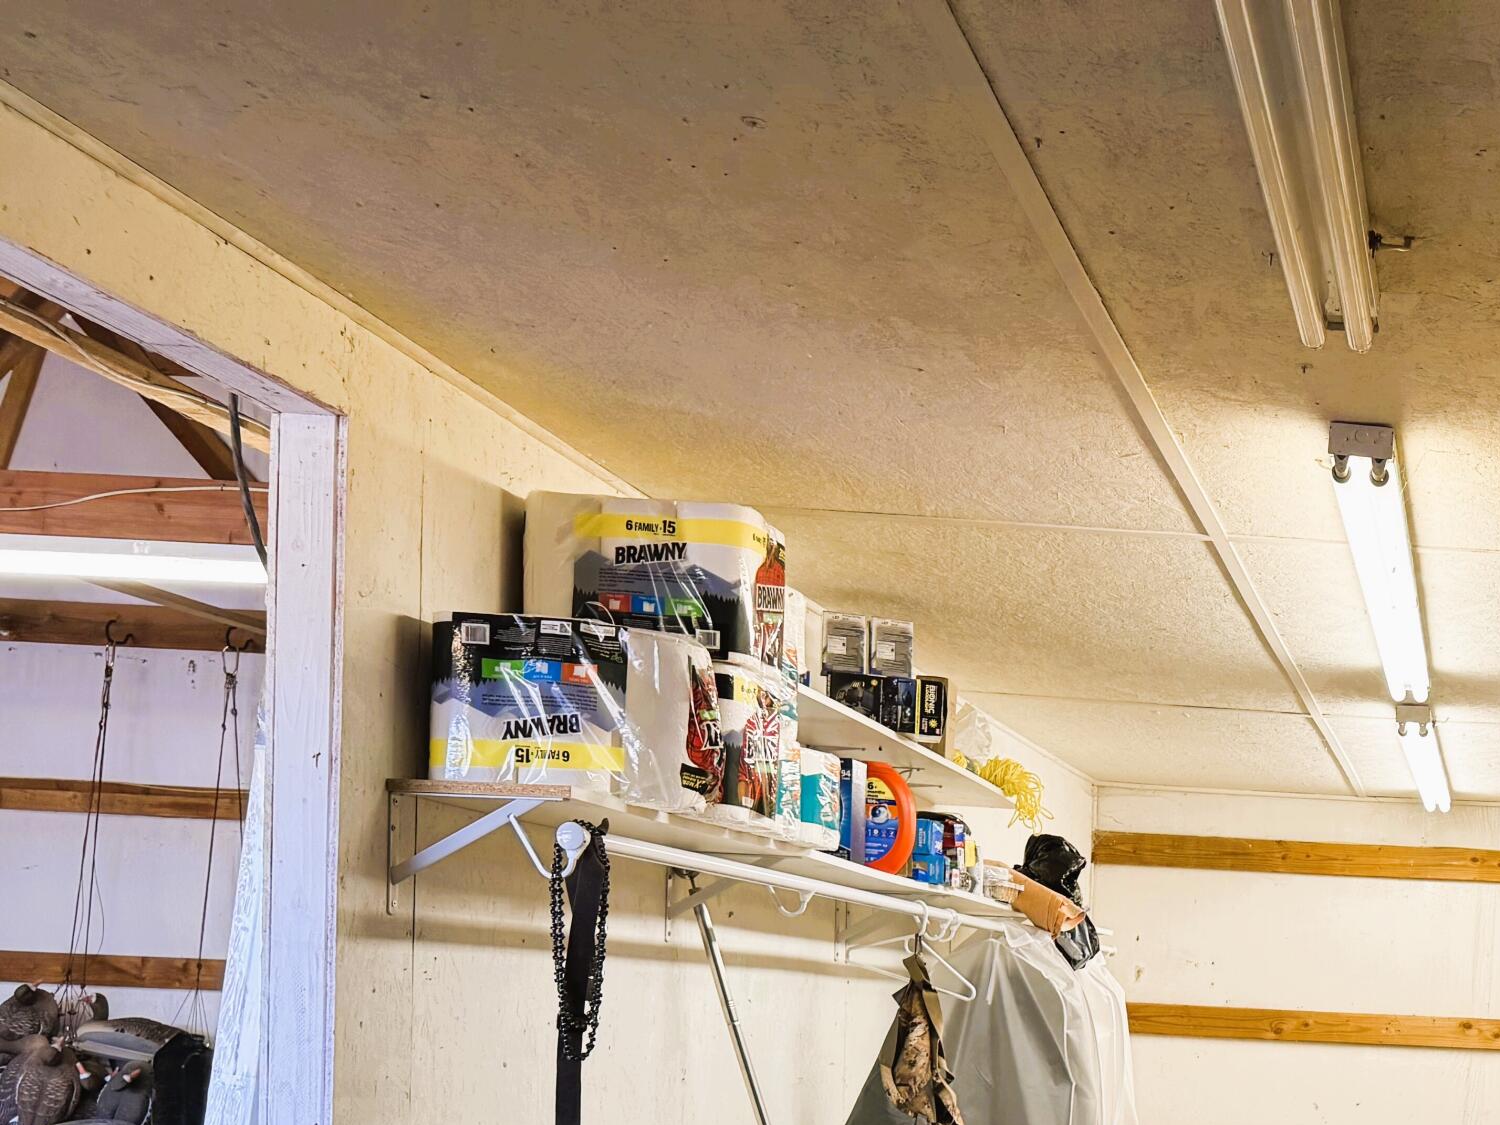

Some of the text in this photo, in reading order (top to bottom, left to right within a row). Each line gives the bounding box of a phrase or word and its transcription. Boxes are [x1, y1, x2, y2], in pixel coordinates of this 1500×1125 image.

[625, 519, 676, 532] 6 FAMILY 15
[614, 542, 687, 565] BRAWNY
[928, 684, 938, 714] BIONIC
[501, 713, 582, 741] BRAWNY
[515, 747, 531, 763] 15
[561, 750, 570, 762] 6
